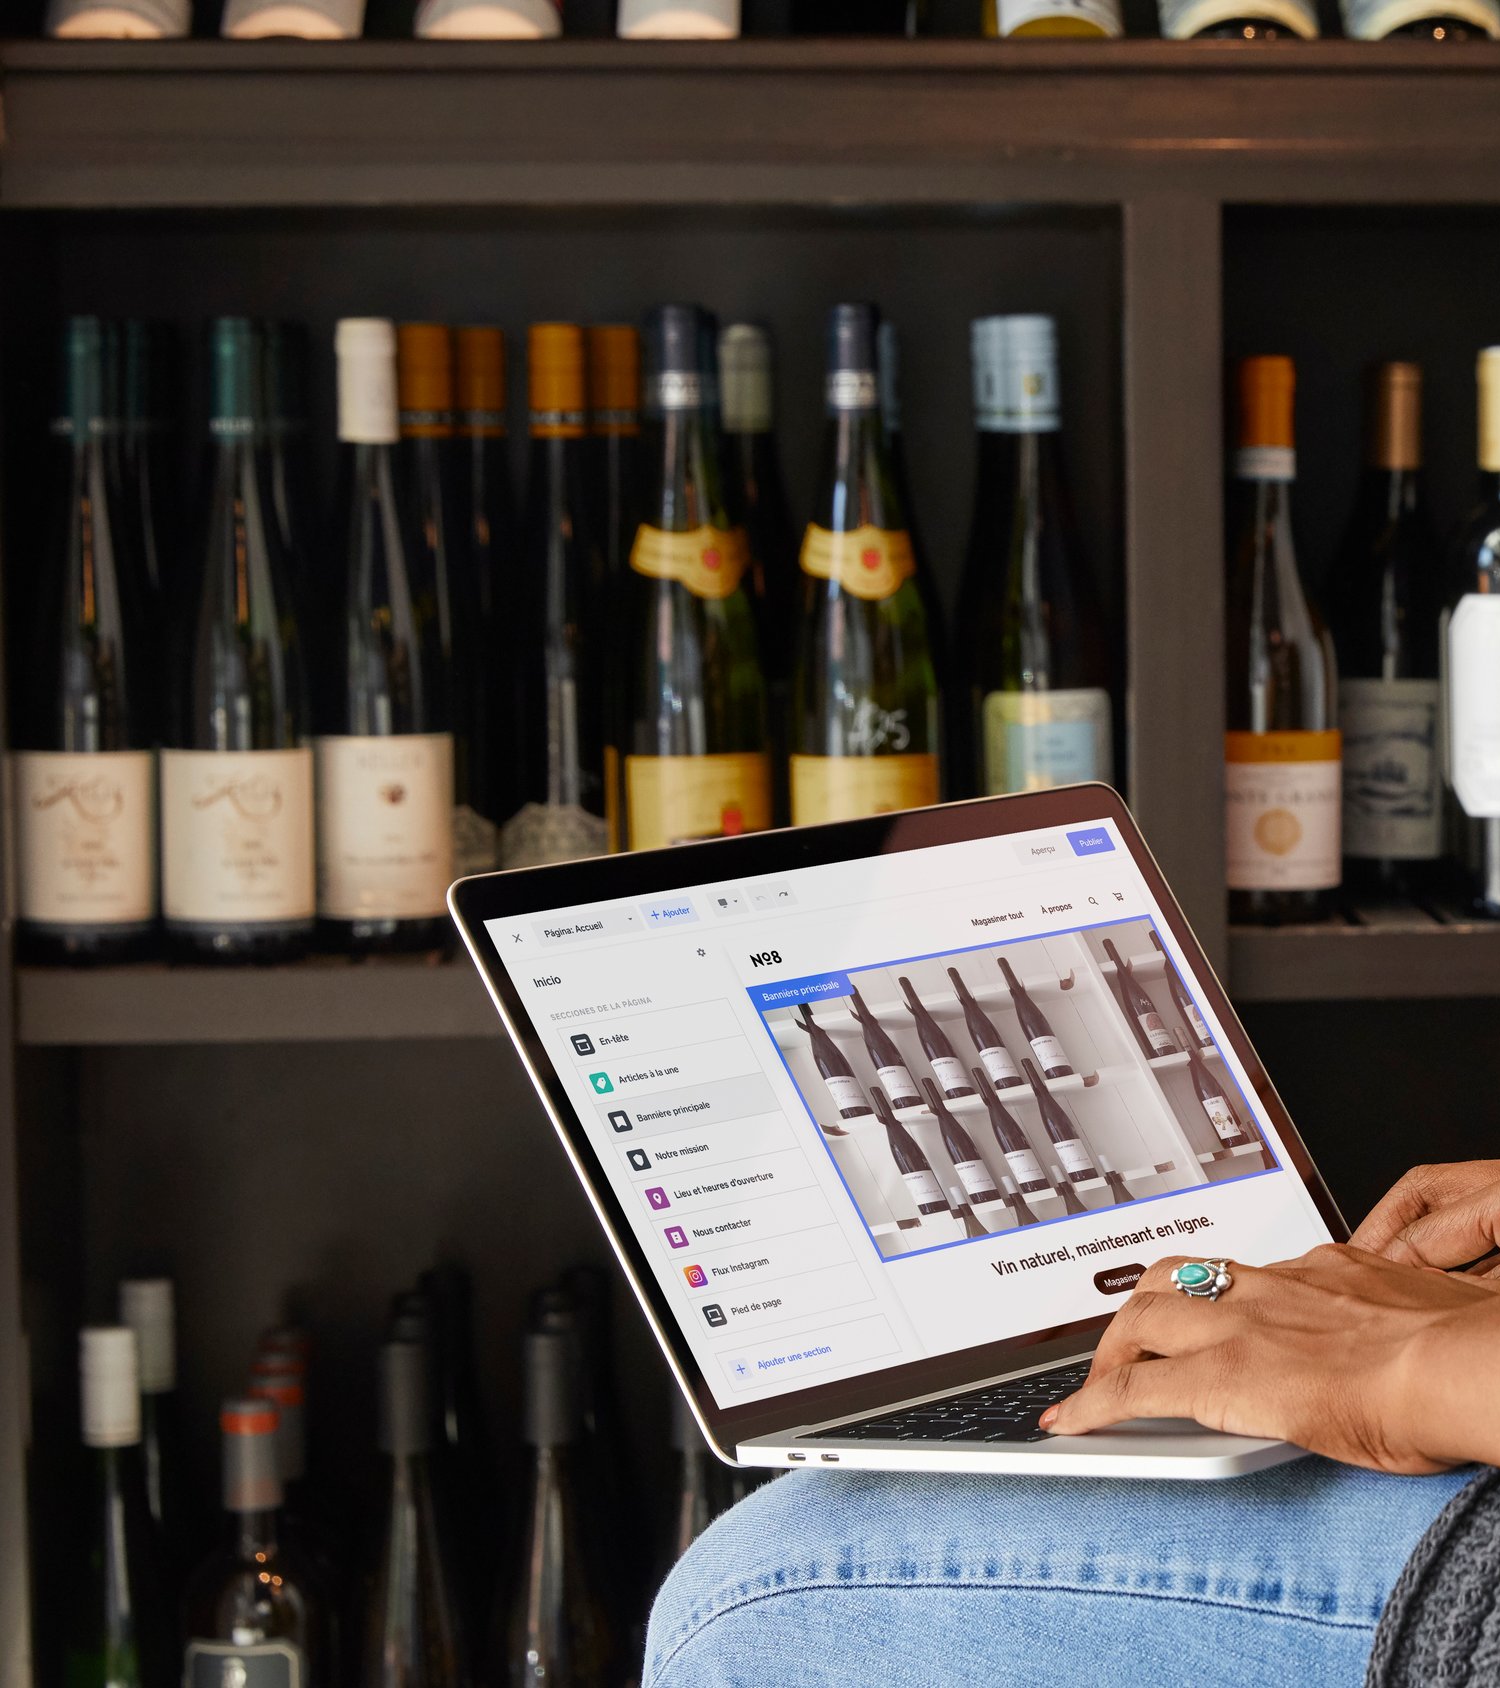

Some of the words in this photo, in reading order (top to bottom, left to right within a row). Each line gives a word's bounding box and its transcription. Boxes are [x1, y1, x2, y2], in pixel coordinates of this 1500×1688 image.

[1078, 837, 1104, 847] Publier
[1031, 846, 1055, 855] Aperçu
[663, 908, 689, 918] Ajouter
[1048, 904, 1072, 914] propos
[971, 915, 1007, 926] Magasiner
[1008, 911, 1024, 920] tout
[576, 921, 603, 933] Accueil
[533, 976, 561, 987] Inicio
[762, 987, 799, 1001] Bannière
[801, 980, 840, 996] principale
[550, 1006, 595, 1021] SECCIONES
[597, 1004, 608, 1013] DE
[610, 1002, 621, 1010] LA
[599, 1034, 629, 1045] En-tête
[619, 1073, 648, 1084] Articles
[664, 1067, 679, 1075] une
[636, 1110, 672, 1122] Bannière
[673, 1102, 710, 1116] principale
[655, 1151, 678, 1160] Notre
[679, 1145, 709, 1155] mission
[674, 1190, 692, 1199] Lieu
[693, 1187, 702, 1195] et
[702, 1182, 729, 1193] heures
[730, 1173, 773, 1187] d'ouverture
[693, 1228, 714, 1237] Nous
[715, 1220, 751, 1233] contacter
[991, 1261, 1018, 1275] Vin
[1019, 1246, 1075, 1270] naturel,
[1076, 1226, 1155, 1257] maintenant
[1156, 1225, 1175, 1237] en
[1175, 1216, 1214, 1235] ligne.
[712, 1267, 730, 1276] Flux
[729, 1259, 769, 1272] Instagram
[1104, 1273, 1141, 1288] Magasiner
[731, 1305, 749, 1315] Pied
[751, 1303, 761, 1311] de
[762, 1299, 782, 1310] page
[758, 1357, 785, 1369] Ajouter
[803, 1346, 831, 1358] section
